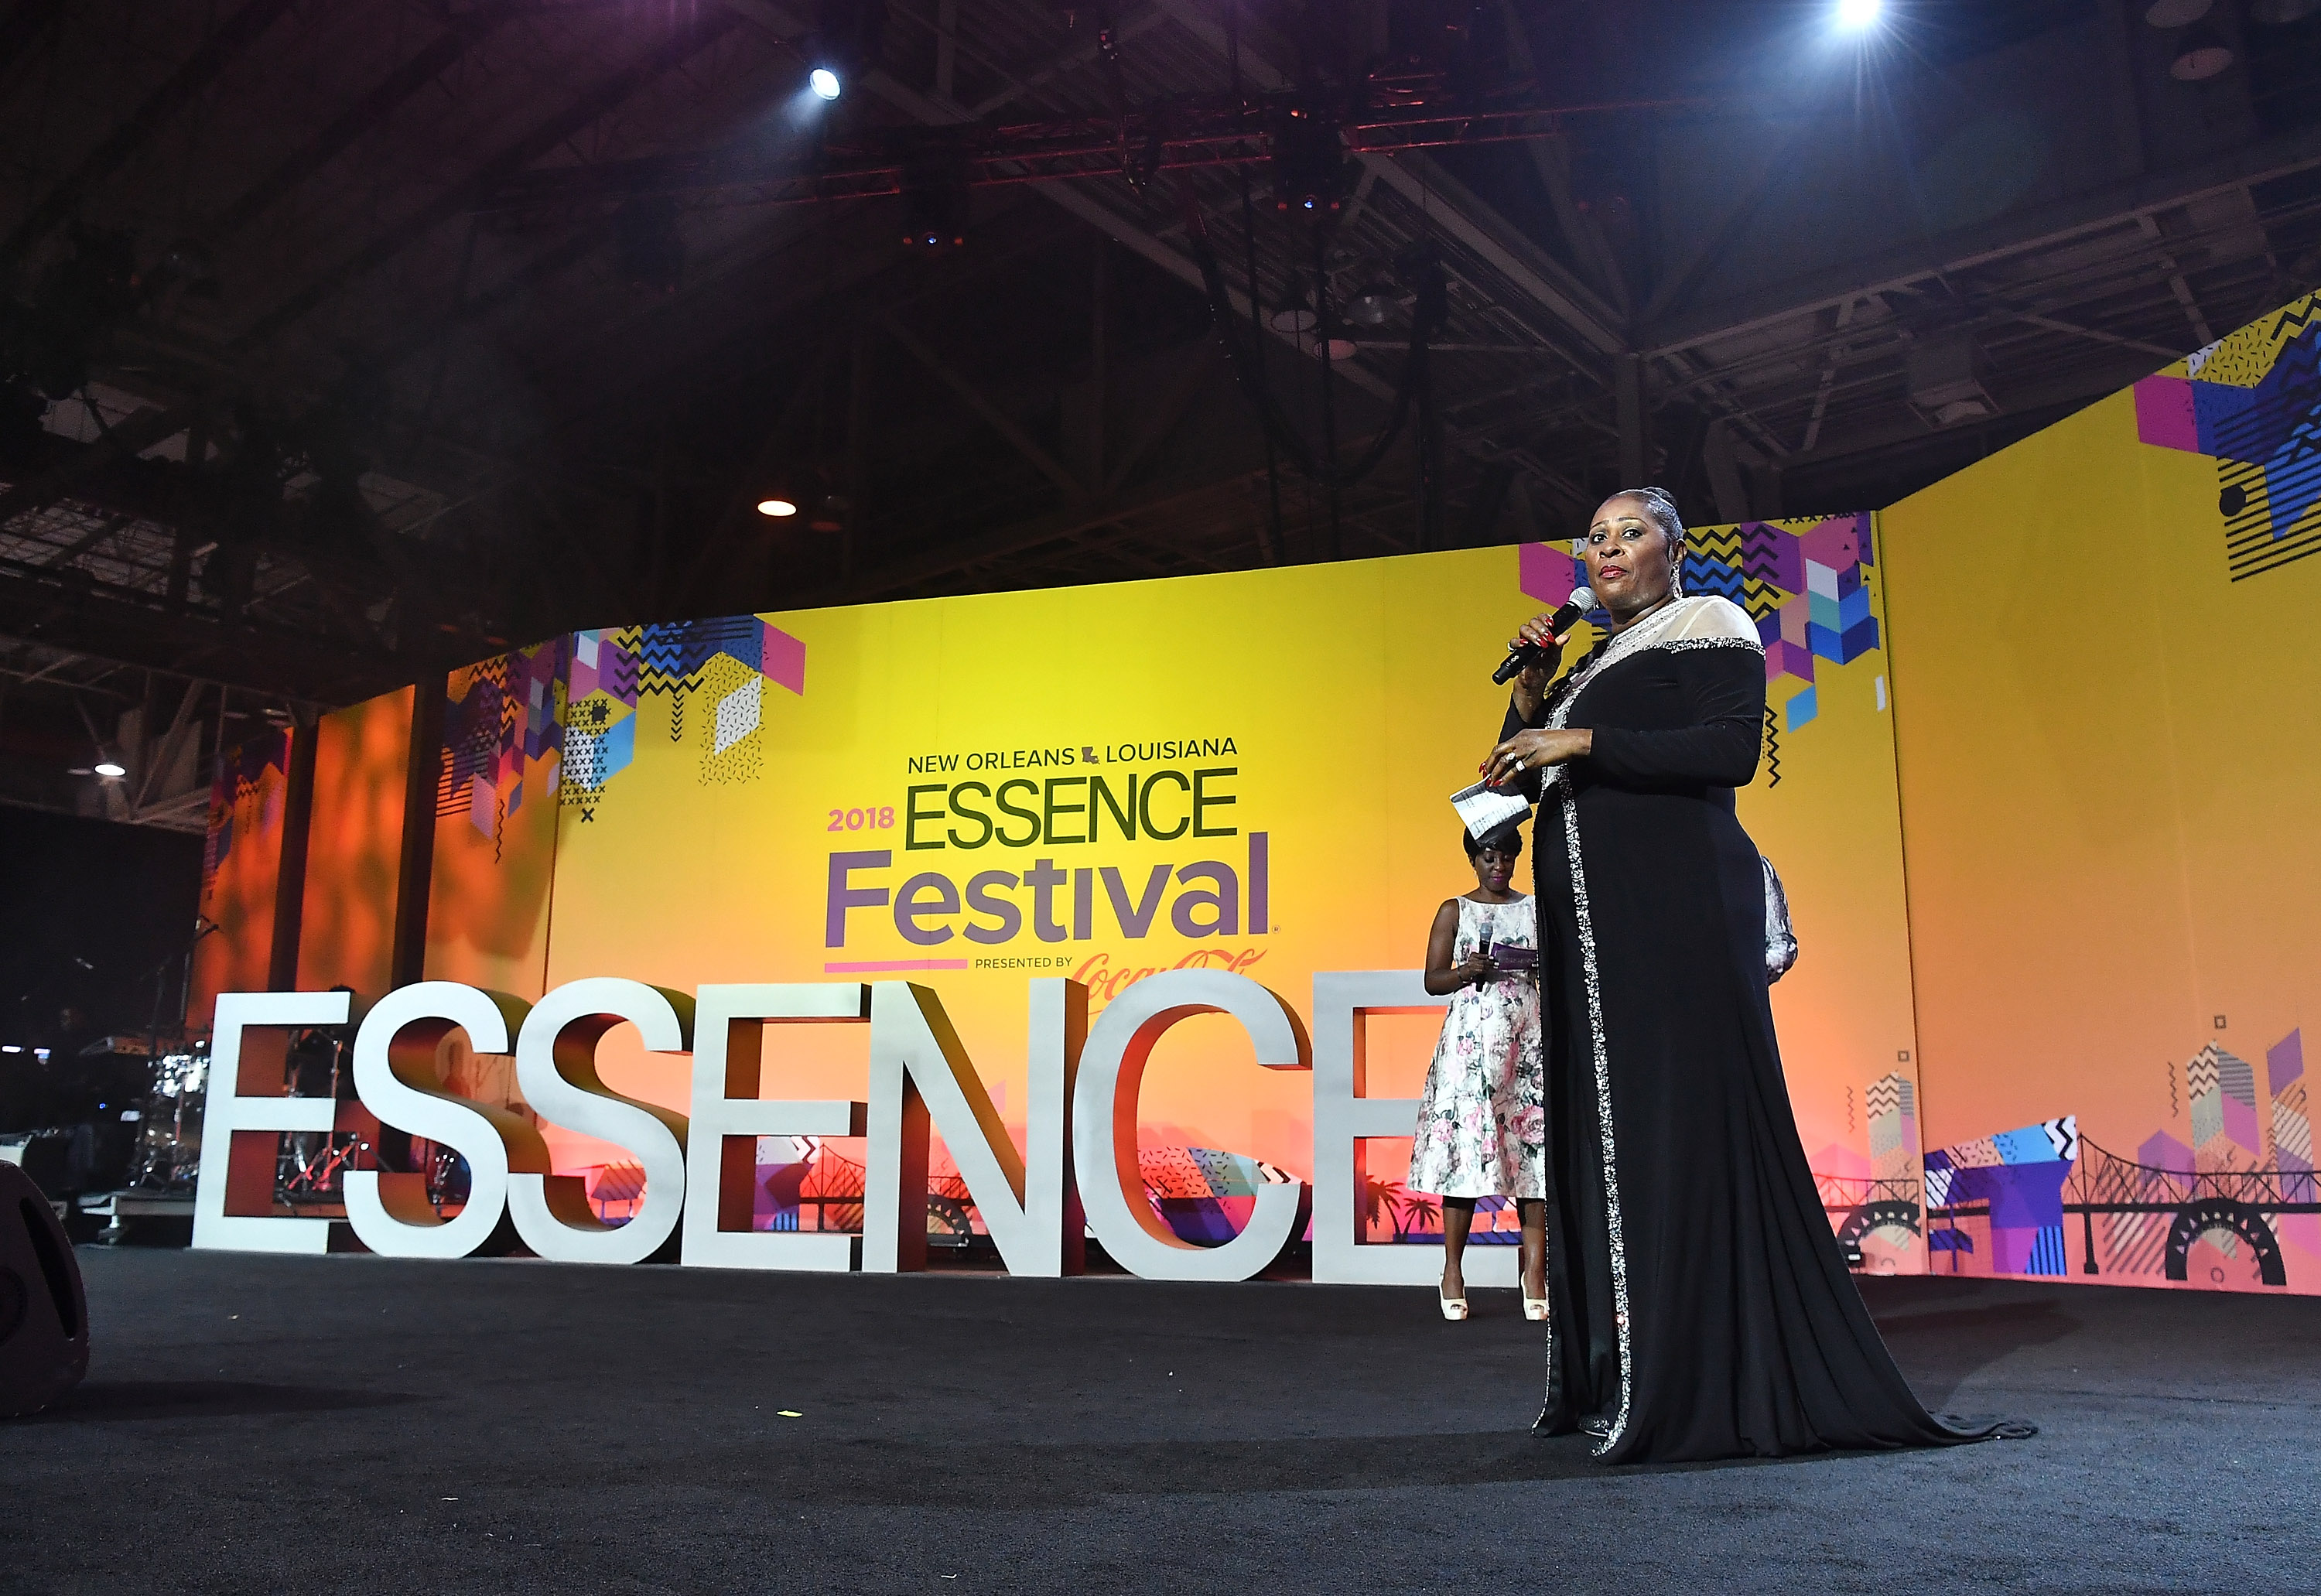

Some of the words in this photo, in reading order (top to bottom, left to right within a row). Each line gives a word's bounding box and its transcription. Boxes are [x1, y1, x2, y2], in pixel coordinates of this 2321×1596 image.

[908, 754, 959, 774] NEW
[966, 748, 1075, 771] ORLEANS
[1106, 737, 1238, 763] LOUISIANA
[827, 806, 896, 832] 2018
[905, 767, 1238, 851] ESSENCE
[975, 958, 1052, 969] PRESENTED
[1055, 956, 1073, 968] BY
[191, 969, 1522, 1287] ESSENCE
